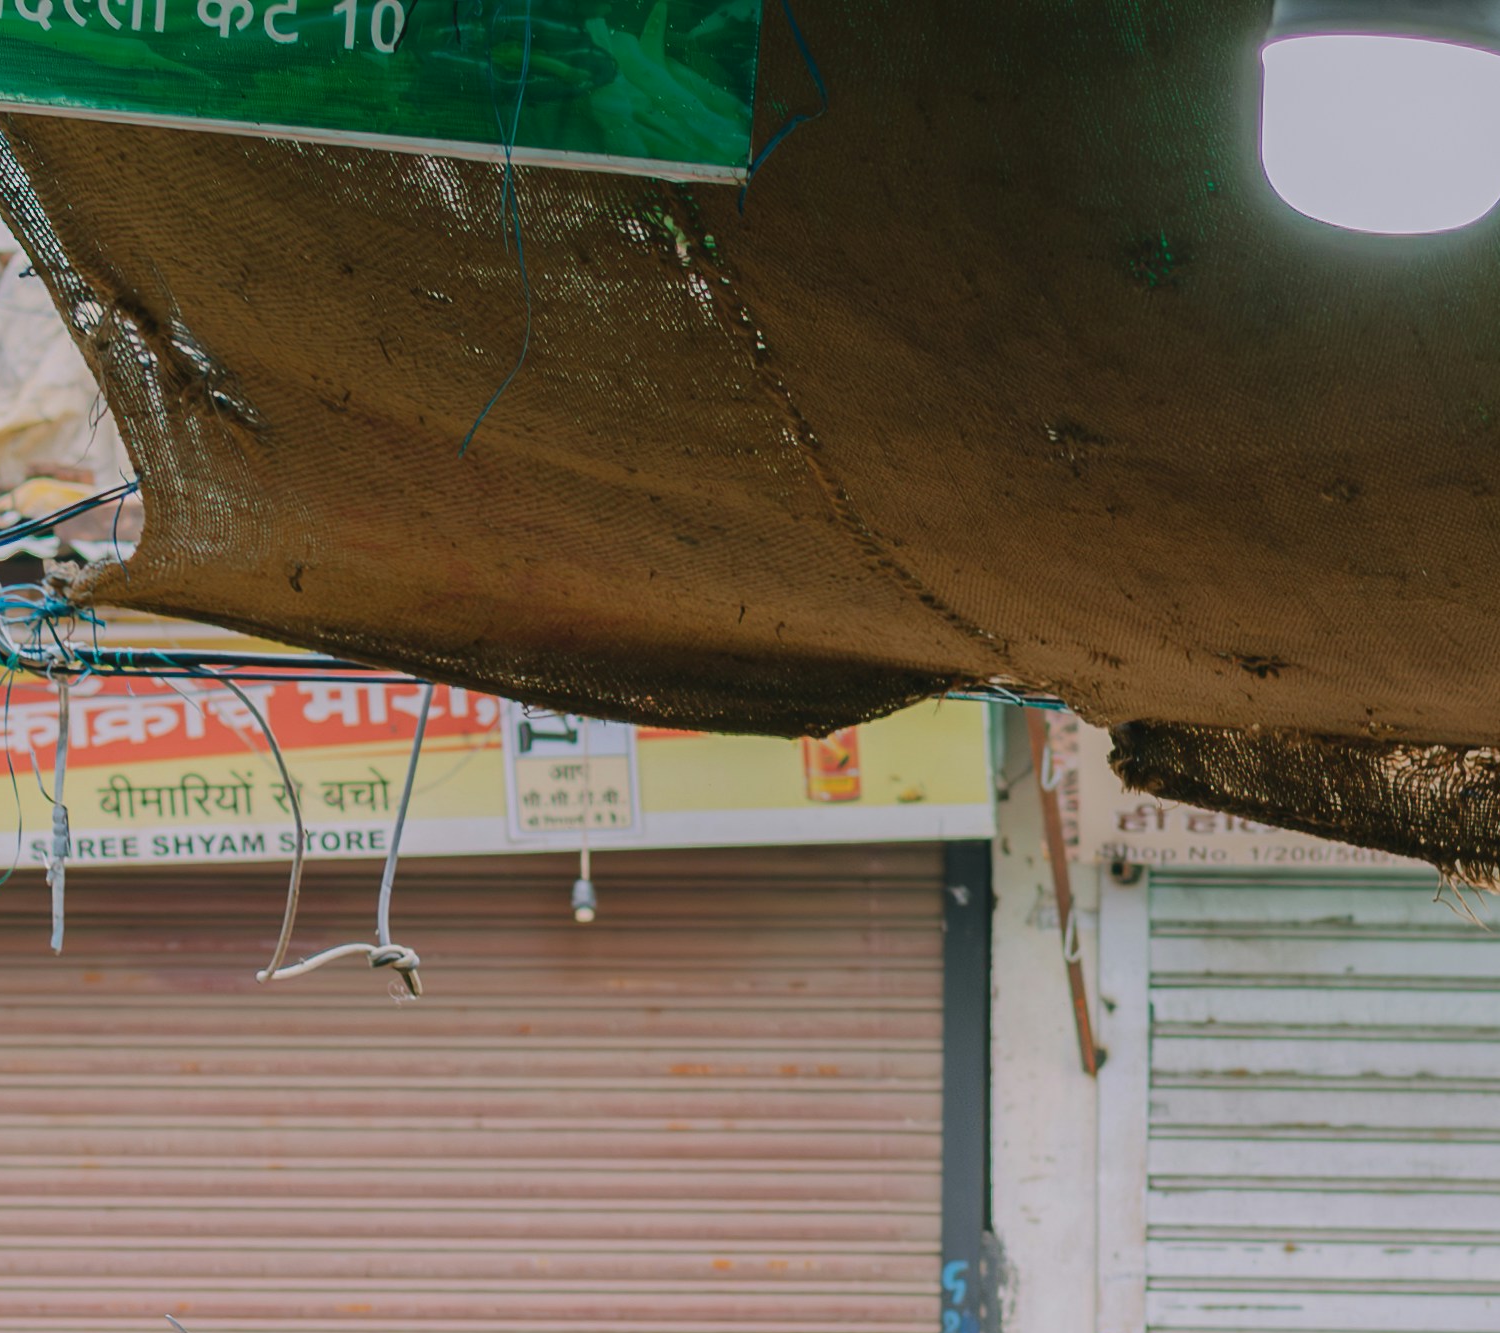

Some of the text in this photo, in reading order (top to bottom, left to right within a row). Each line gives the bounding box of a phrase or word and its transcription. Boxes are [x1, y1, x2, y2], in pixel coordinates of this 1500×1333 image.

[333, 0, 406, 54] 10
[97, 766, 392, 820] बीमारियों स बचो
[152, 833, 266, 857] SHYAM
[278, 829, 386, 852] STORE
